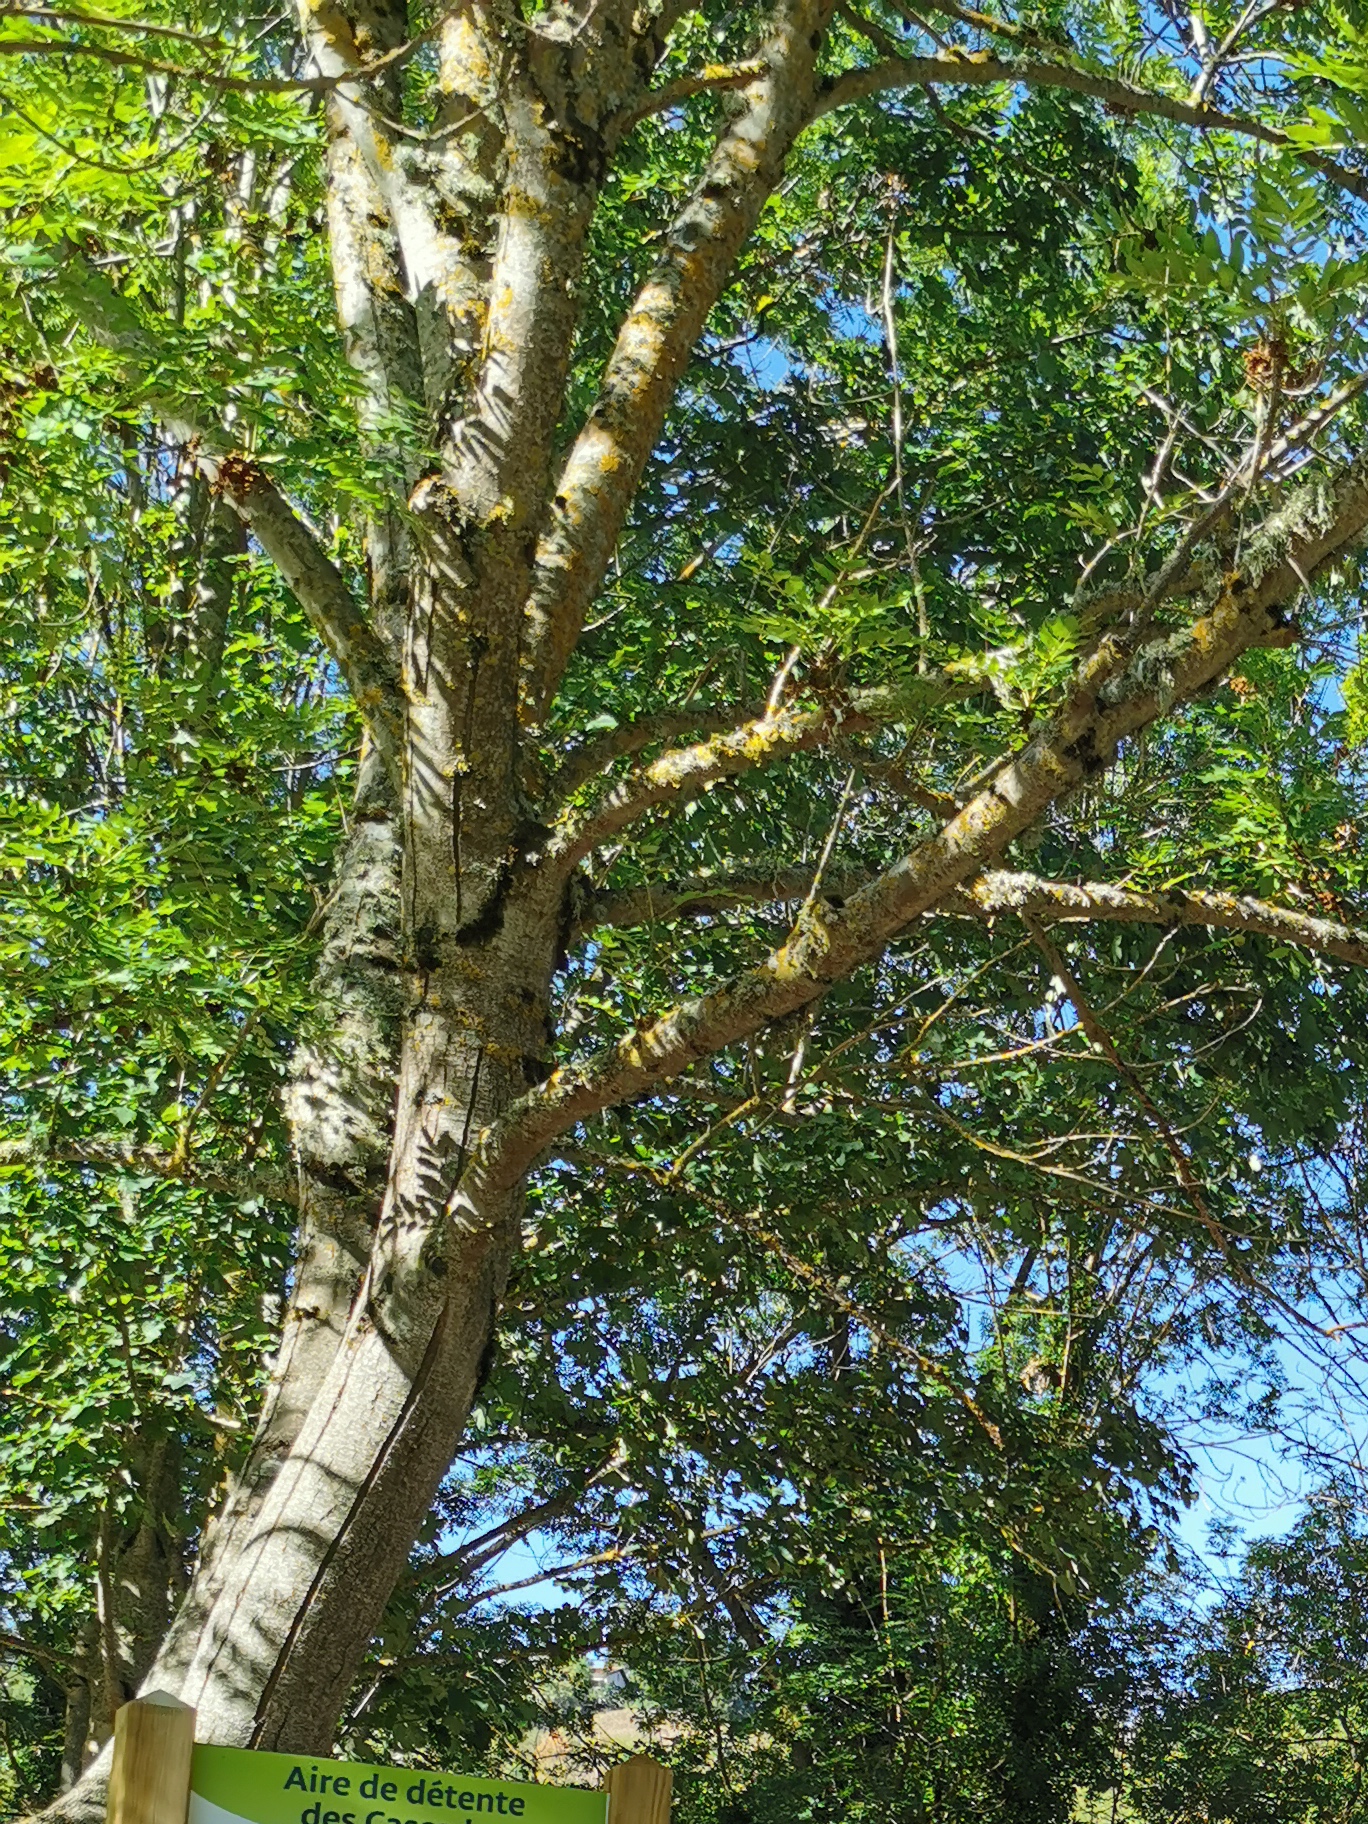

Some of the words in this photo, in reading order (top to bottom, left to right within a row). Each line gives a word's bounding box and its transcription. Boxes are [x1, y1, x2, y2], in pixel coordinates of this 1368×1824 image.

[283, 1766, 350, 1797] Aire
[359, 1773, 397, 1801] de
[406, 1779, 526, 1816] détente
